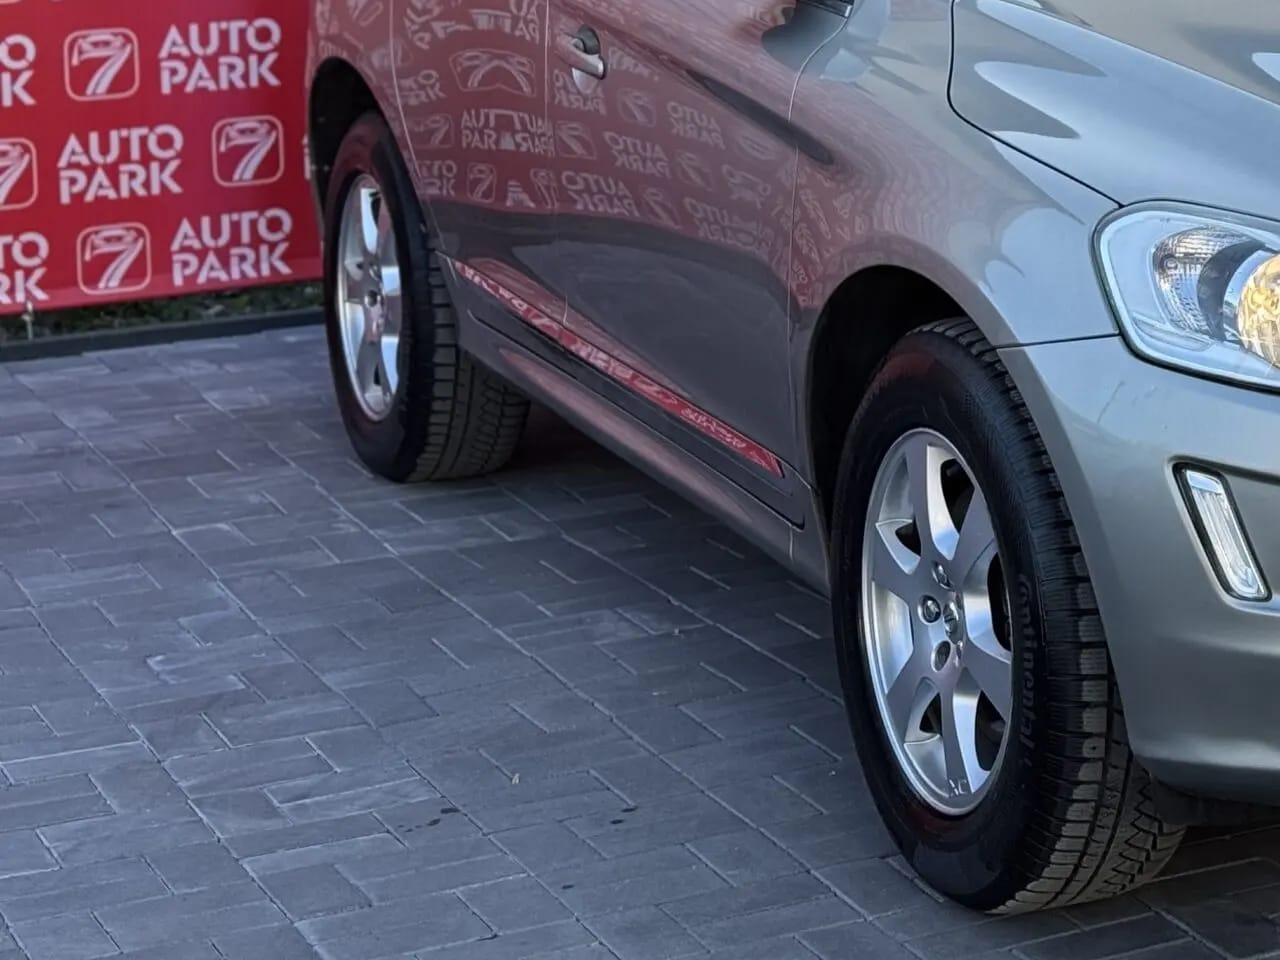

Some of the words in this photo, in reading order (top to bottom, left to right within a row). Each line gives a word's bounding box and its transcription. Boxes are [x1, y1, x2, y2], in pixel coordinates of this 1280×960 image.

[159, 19, 280, 61] AUTO
[160, 53, 278, 94] PARK
[58, 125, 183, 170] AUTO
[60, 160, 181, 204] PARK
[171, 209, 291, 254] AUTO
[171, 240, 291, 286] PARK
